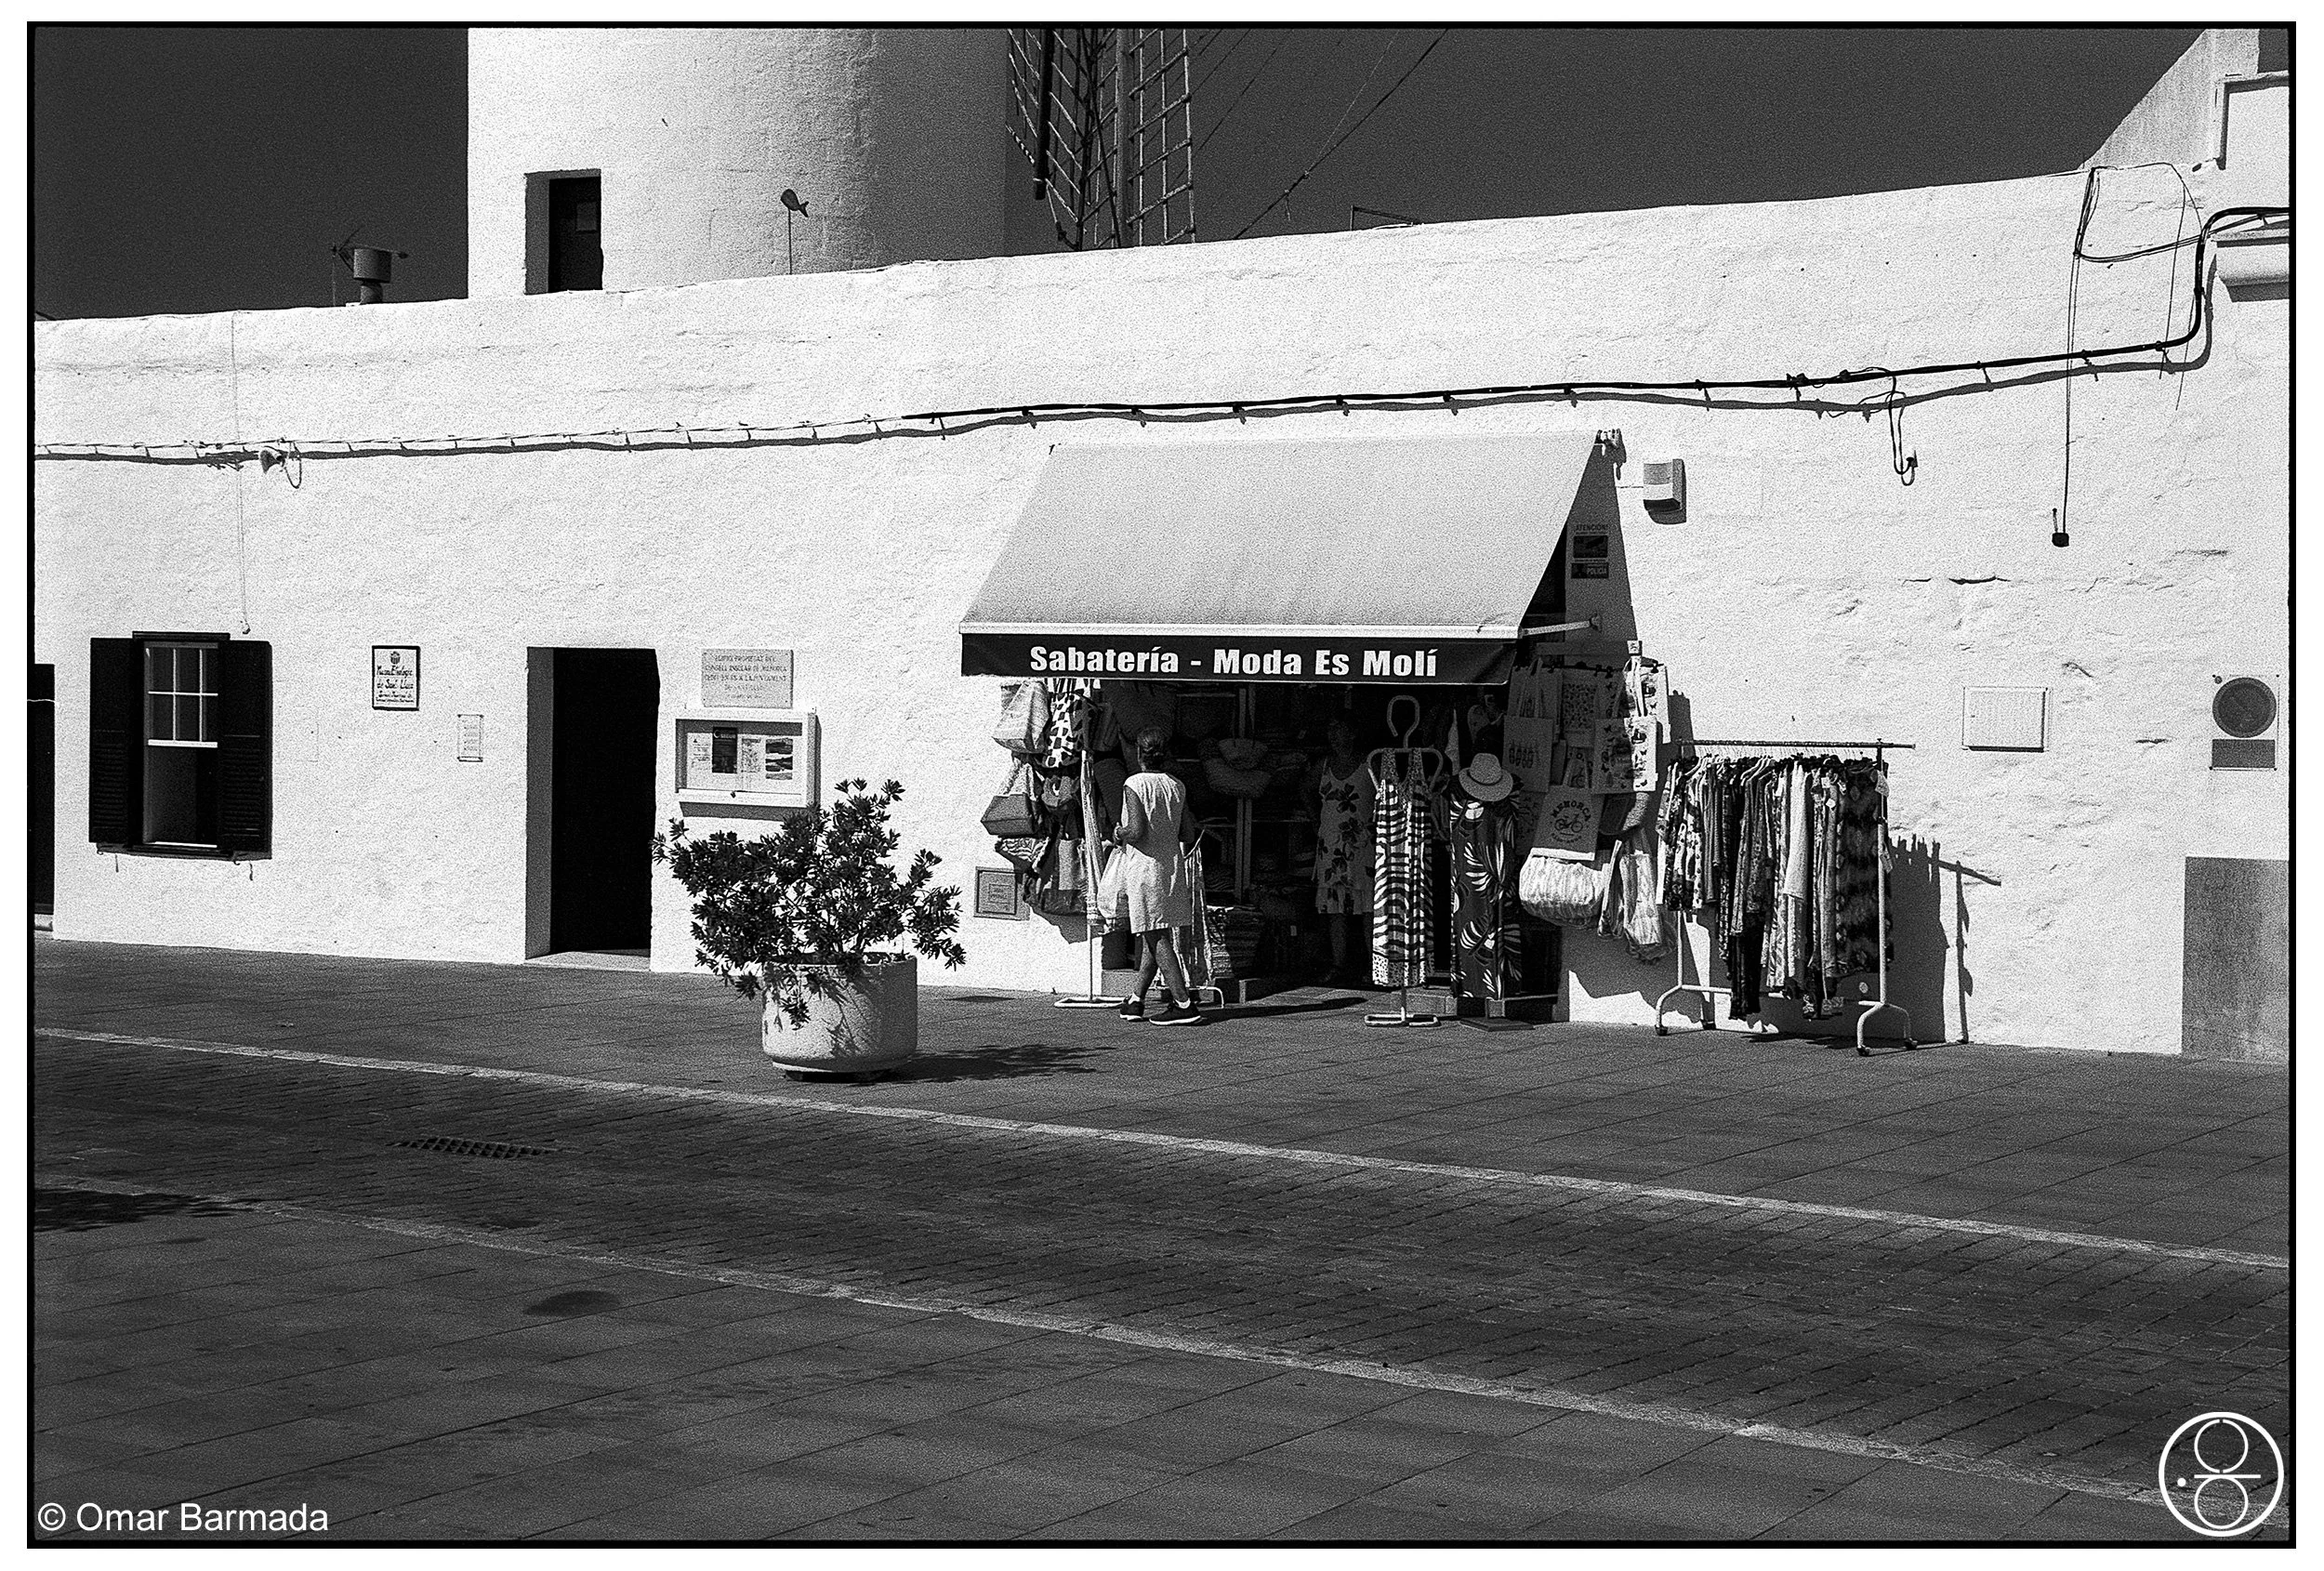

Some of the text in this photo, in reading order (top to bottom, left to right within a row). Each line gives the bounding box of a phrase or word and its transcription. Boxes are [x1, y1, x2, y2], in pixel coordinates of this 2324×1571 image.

[1030, 646, 1179, 673] Sabatería
[1213, 649, 1302, 675] Moda
[1314, 650, 1350, 676] Es
[1363, 648, 1437, 677] Molí
[1551, 800, 1591, 822] MENORCA
